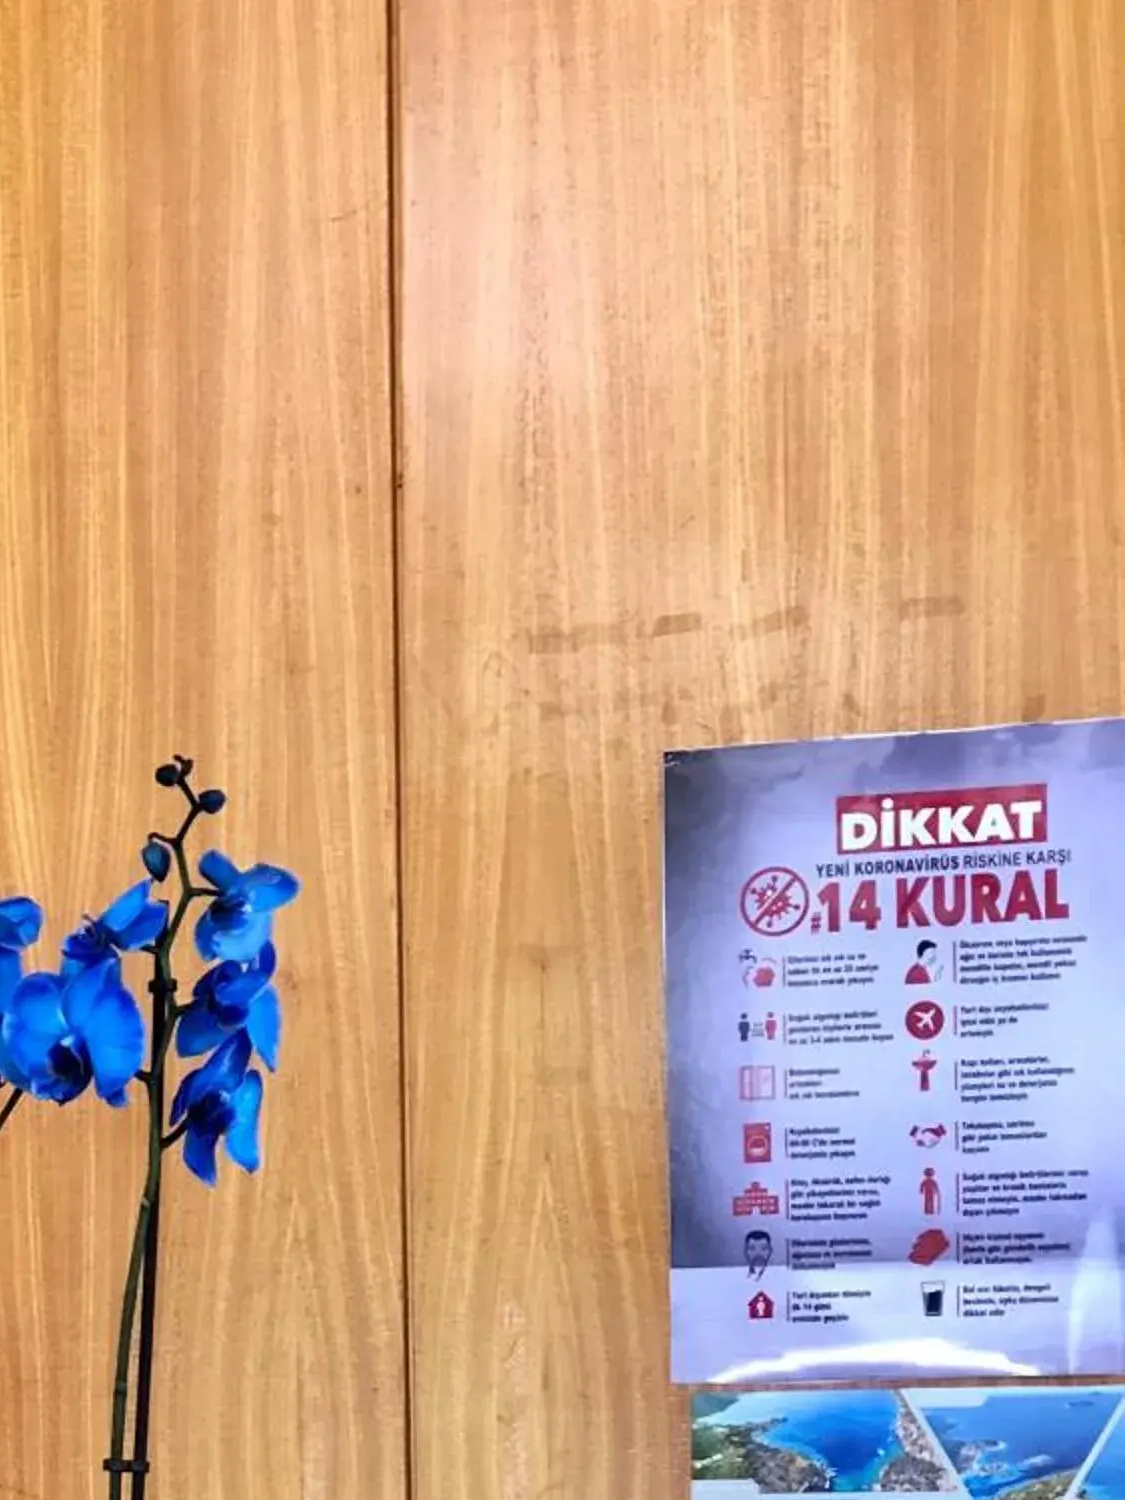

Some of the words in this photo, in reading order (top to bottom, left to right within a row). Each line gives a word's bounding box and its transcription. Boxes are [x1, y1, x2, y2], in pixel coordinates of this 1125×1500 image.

[841, 798, 1042, 850] DİKKAT
[816, 861, 850, 878] YENİ
[855, 854, 959, 876] KORONAVİRÜS
[1026, 848, 1072, 866] KARŞI
[896, 869, 1070, 928] KURAL
